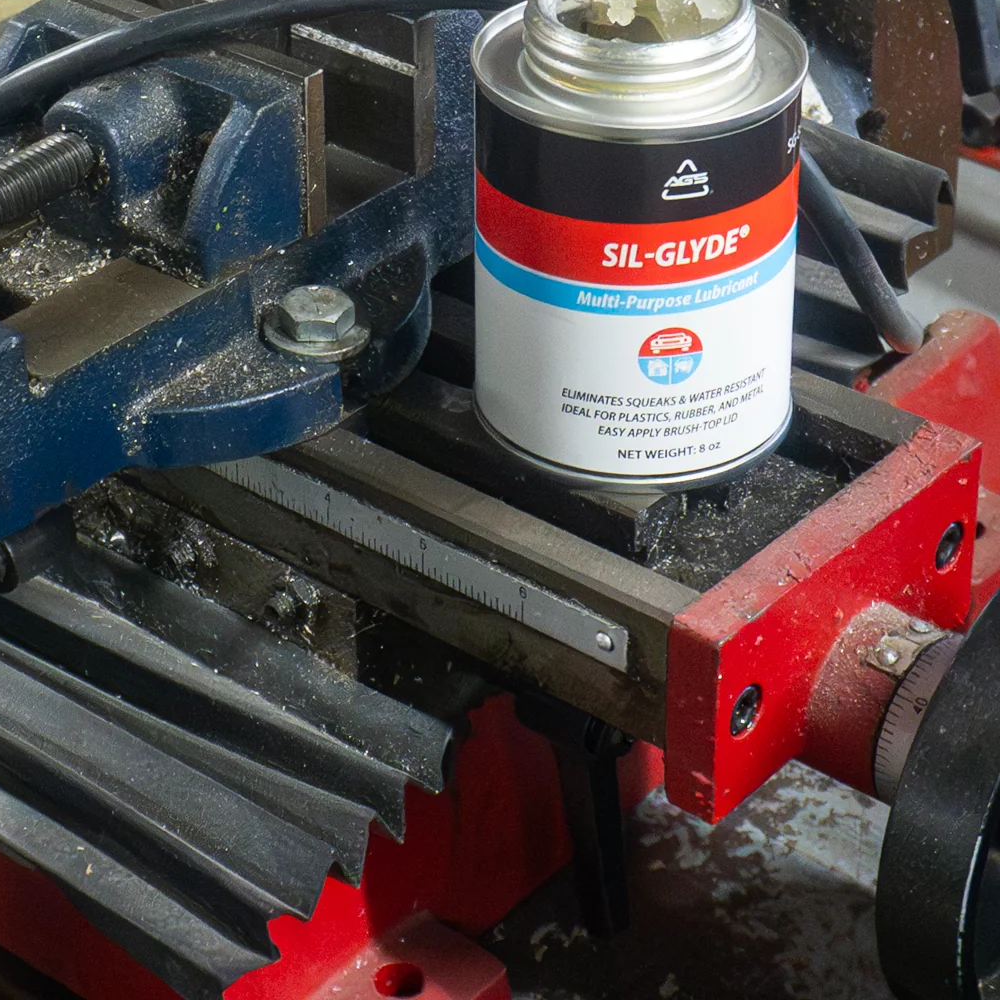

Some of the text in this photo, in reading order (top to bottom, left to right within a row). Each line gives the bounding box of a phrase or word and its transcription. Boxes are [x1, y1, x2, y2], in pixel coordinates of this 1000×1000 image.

[664, 172, 708, 187] AGS
[576, 270, 759, 314] Multi-Purpose Lubricant
[561, 368, 766, 409] ELIMINATES SQUEAKS & WATER RESISTANT
[561, 384, 764, 424] IDEAL FOR PLASTICS, RUBBER, AND METAL
[597, 412, 738, 439] EASY APPLY BRUSH-TOP LID
[617, 441, 721, 460] NET WEIGHT: 8 oz
[519, 586, 528, 599] 6
[912, 696, 929, 716] 40
